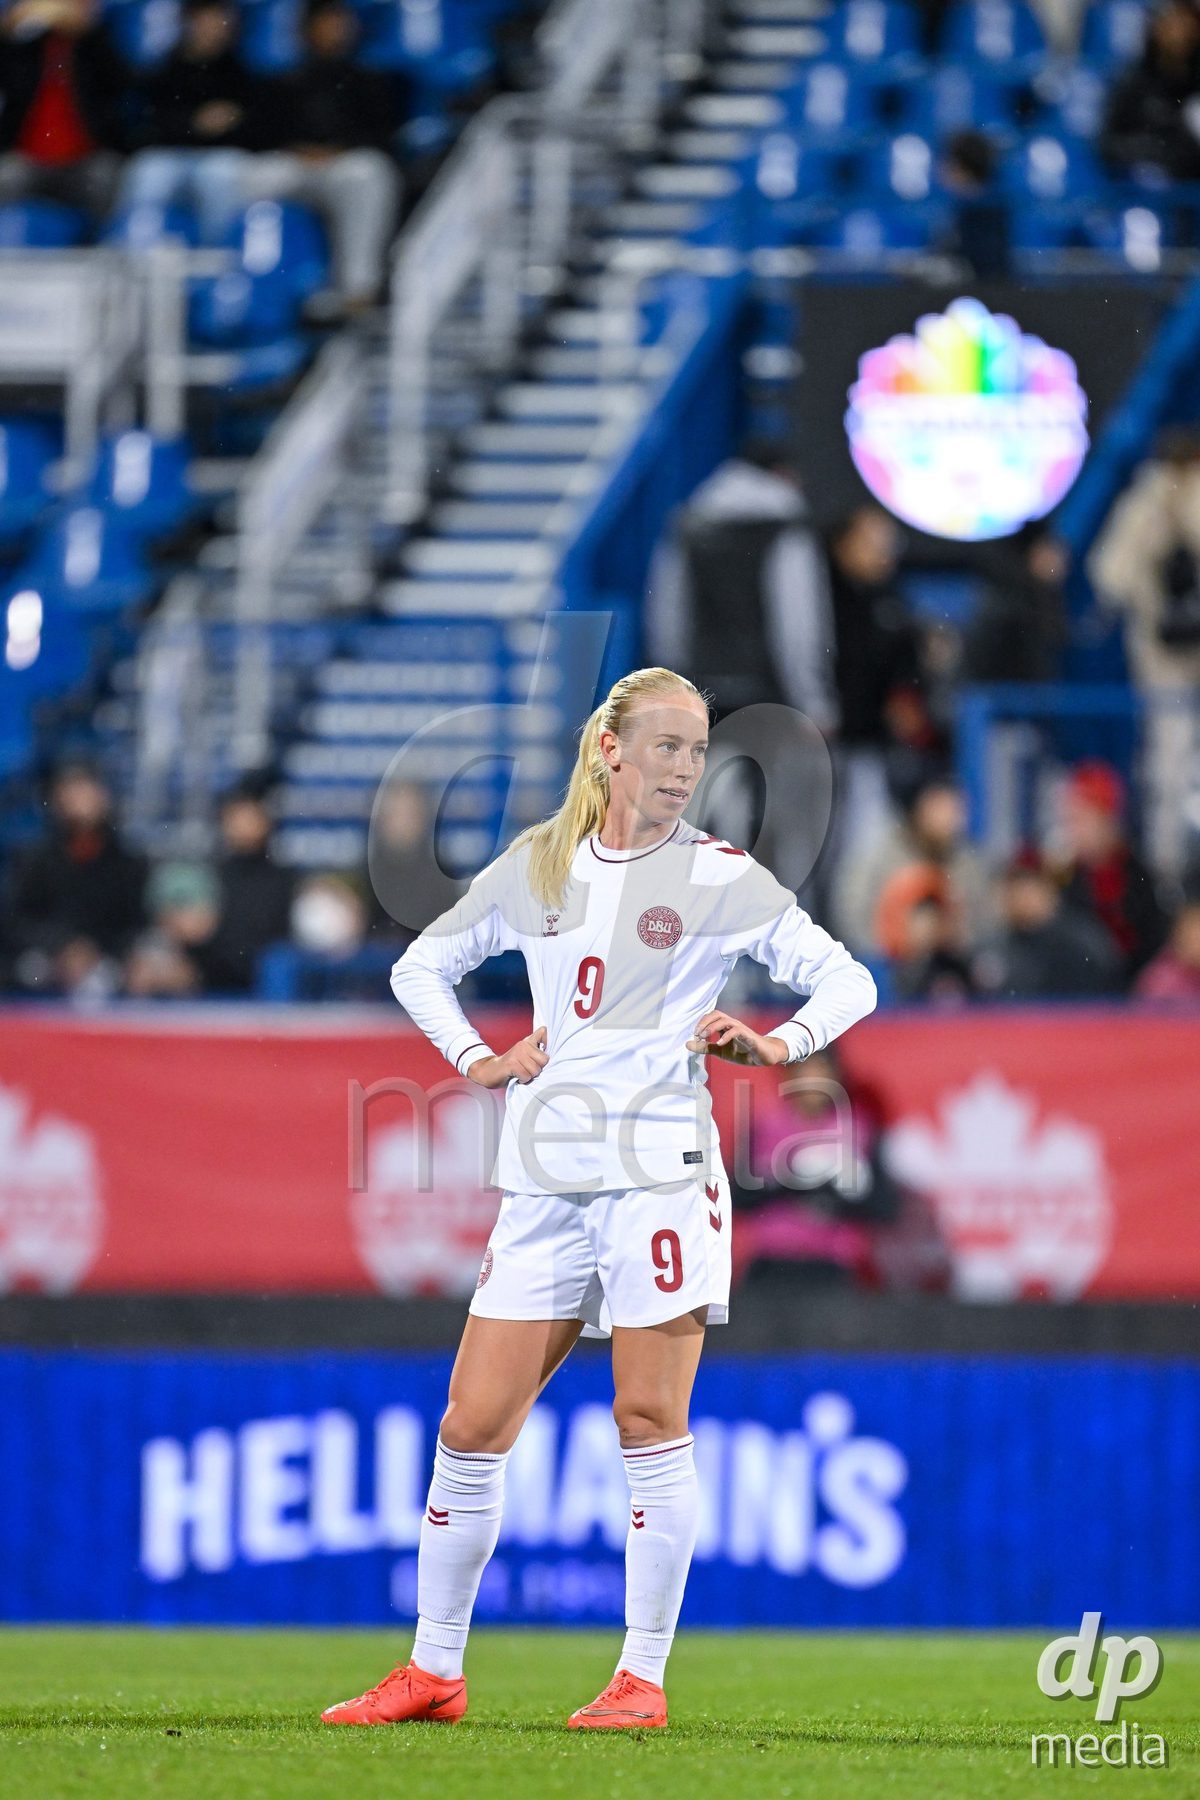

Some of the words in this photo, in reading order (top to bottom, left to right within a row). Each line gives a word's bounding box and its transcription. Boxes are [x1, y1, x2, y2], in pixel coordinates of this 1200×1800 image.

[647, 920, 672, 934] DBU
[574, 956, 605, 1019] 9
[651, 1229, 684, 1293] 9
